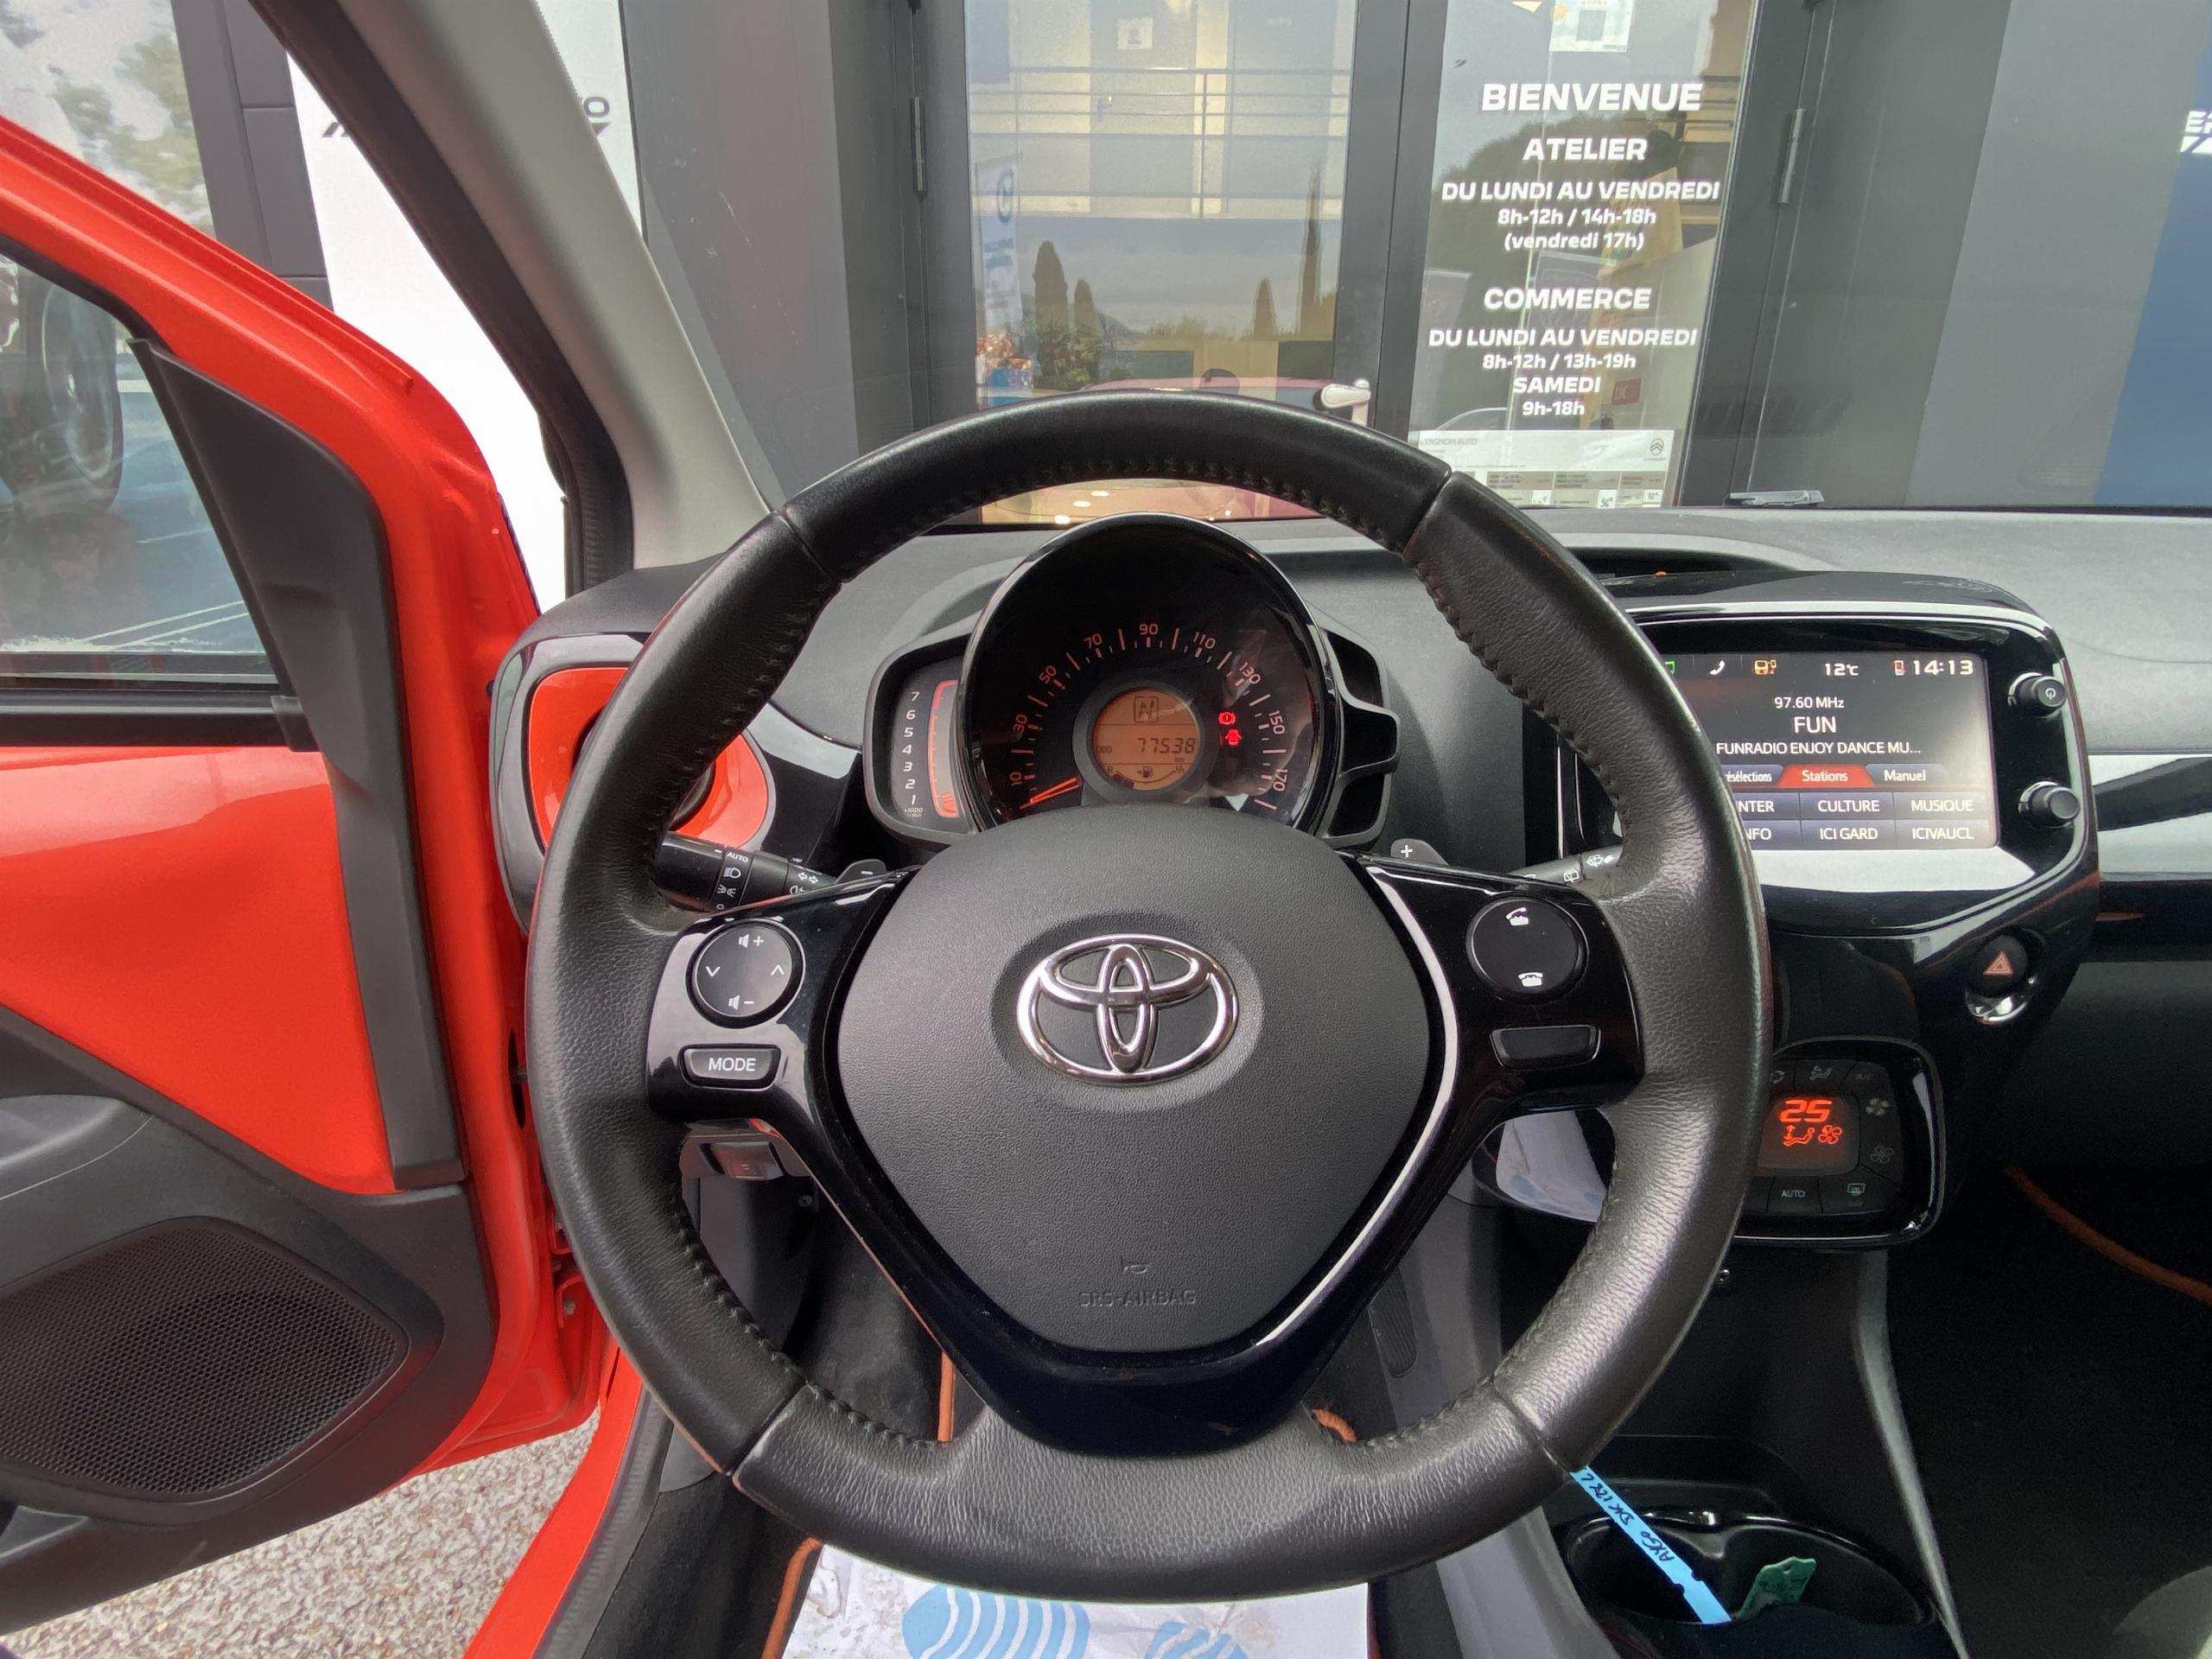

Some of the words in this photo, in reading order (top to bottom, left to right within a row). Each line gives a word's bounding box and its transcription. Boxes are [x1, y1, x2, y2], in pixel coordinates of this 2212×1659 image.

[1482, 82, 1702, 111] BIENVENUE
[1522, 138, 1648, 161] ATELIER
[1441, 181, 1475, 200] DU
[1481, 181, 1552, 200] LUNDI
[1557, 181, 1592, 200] AU
[1599, 181, 1719, 200] VENDREDI
[1497, 208, 1563, 226] 8h-12h
[1567, 208, 1578, 226] /
[1581, 208, 1656, 225] 14h-18h
[1503, 232, 1598, 251] (vendredi
[1603, 232, 1645, 251] 17h)
[1484, 287, 1652, 310] COMMERCE
[1428, 328, 1462, 346] DU
[1467, 328, 1535, 346] LUNDI
[1540, 328, 1574, 346] AU
[1580, 328, 1698, 346] VENDREDI
[1482, 353, 1547, 370] 8h-12h
[1549, 353, 1560, 370] /
[1563, 353, 1637, 369] 13h-19h
[1513, 376, 1600, 394] SAMEDI
[1522, 401, 1585, 416] 9h-18h
[1140, 624, 1159, 635] 90
[1084, 632, 1103, 648] 70
[1193, 632, 1217, 650] 110
[1039, 664, 1058, 684] 50
[1238, 662, 1261, 683] 130
[1913, 660, 1974, 675] 14:13
[912, 691, 919, 701] 7
[1774, 696, 1814, 709] 97.60
[1815, 696, 1845, 709] MHz
[906, 710, 916, 720] 6
[1269, 709, 1286, 734] 150
[1013, 714, 1027, 734] 30
[1793, 716, 1836, 734] FUN
[904, 728, 914, 737] 5
[902, 745, 912, 754] 4
[1137, 737, 1196, 754] 77538
[1716, 742, 1787, 755] FUNRADIO
[1790, 742, 1834, 754] ENJOY
[1837, 742, 1885, 754] DANCE
[1888, 742, 1922, 754] MU...
[903, 762, 912, 772] 3
[1011, 772, 1023, 787] 10
[1273, 769, 1288, 791] 170
[1802, 769, 1848, 782] Stations
[1884, 769, 1926, 782] Manuel
[906, 779, 915, 789] 2
[911, 795, 917, 805] 1
[1817, 799, 1880, 812] CULTURE
[1910, 798, 1975, 813] MUSIQUE
[1745, 828, 1772, 841] NFO
[1820, 828, 1838, 840] ICI
[1840, 827, 1878, 840] GARD
[727, 851, 749, 863] AUTO
[708, 1057, 756, 1072] MODE
[1779, 1098, 1833, 1122] 25
[1781, 1189, 1806, 1199] AUTO
[1080, 1290, 1197, 1308] SRS-AIRBAG
